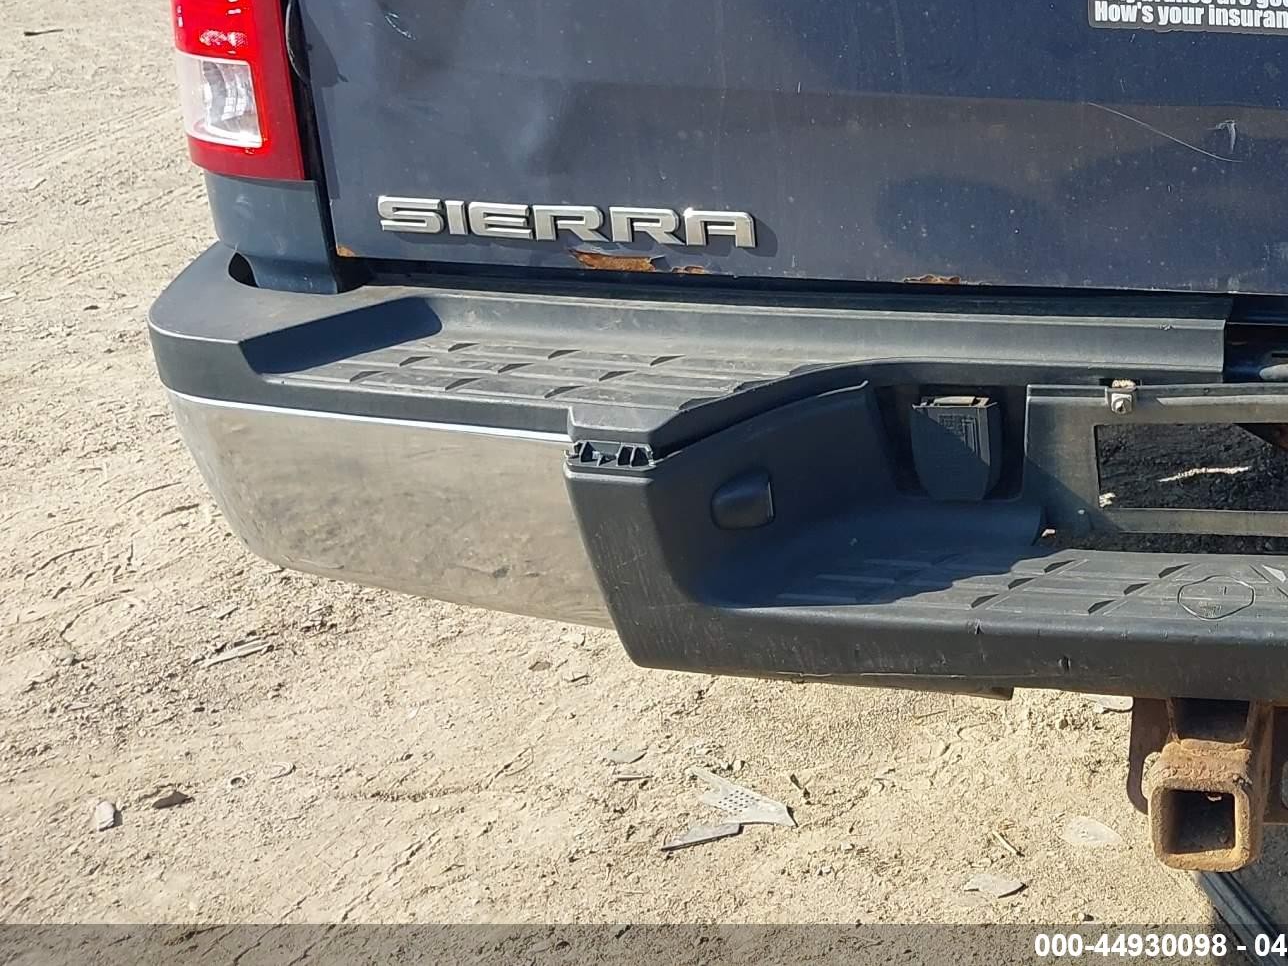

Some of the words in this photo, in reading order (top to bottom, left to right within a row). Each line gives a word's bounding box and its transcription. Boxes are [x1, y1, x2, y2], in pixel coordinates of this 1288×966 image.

[1094, 1, 1155, 23] How's
[1157, 8, 1204, 26] your
[377, 195, 757, 248] SIERRA
